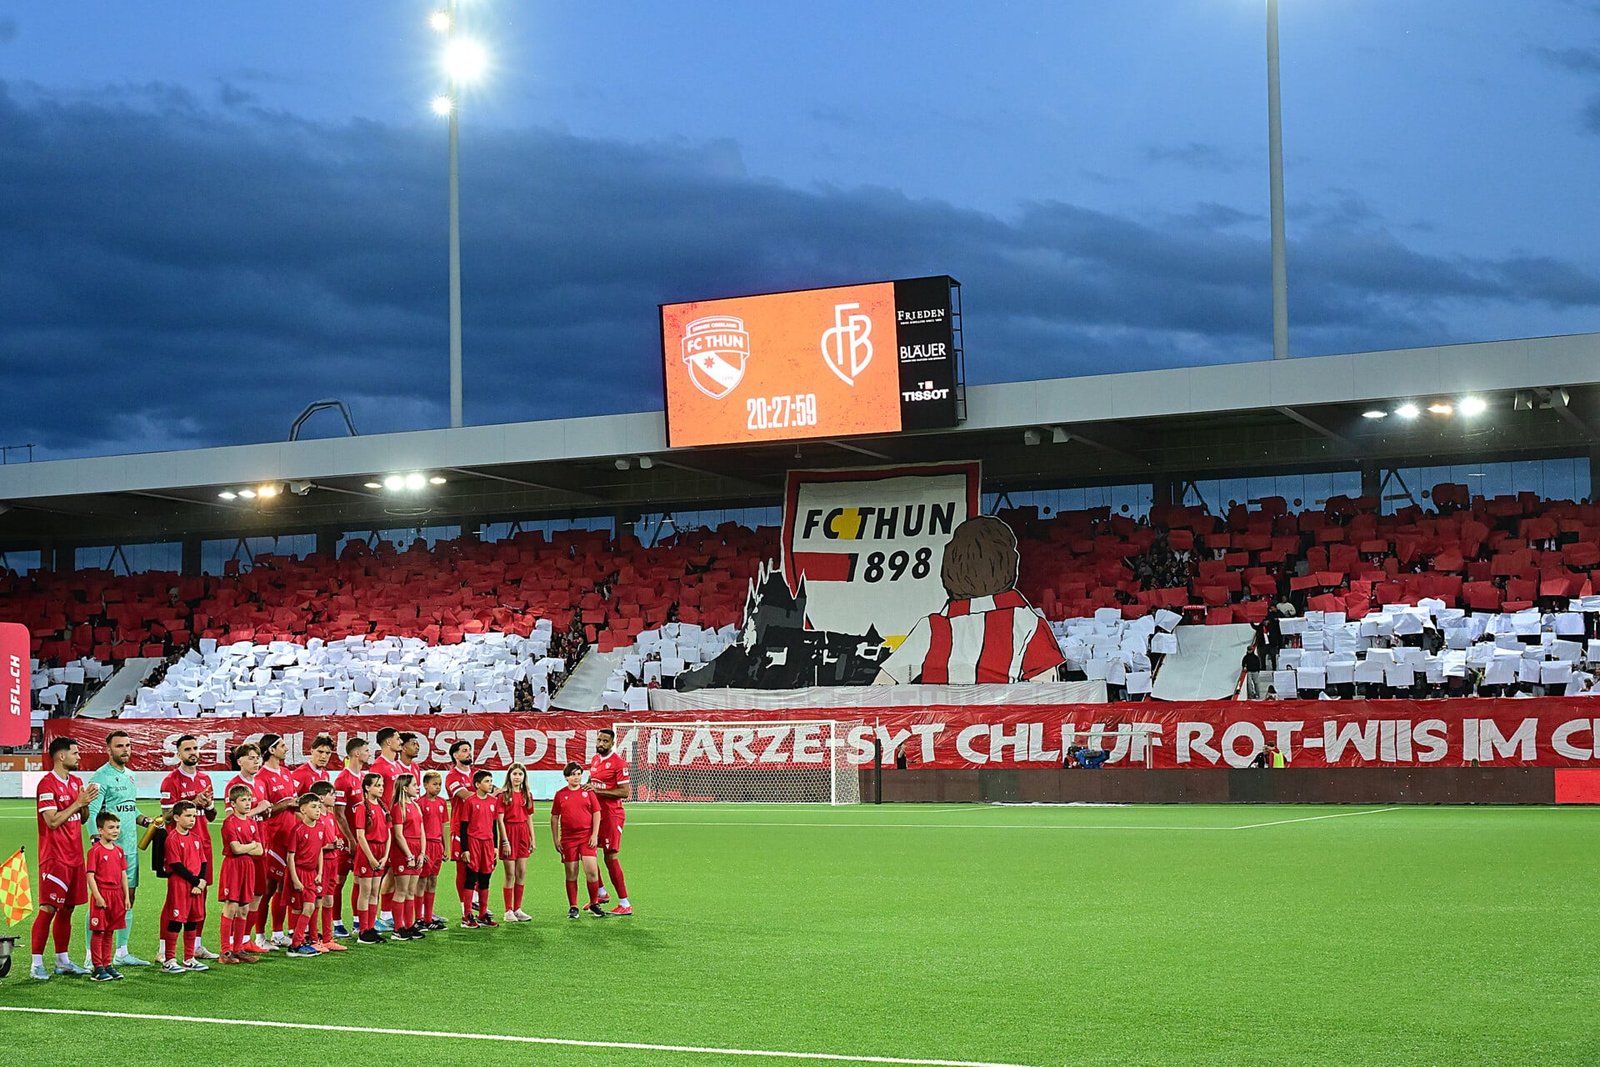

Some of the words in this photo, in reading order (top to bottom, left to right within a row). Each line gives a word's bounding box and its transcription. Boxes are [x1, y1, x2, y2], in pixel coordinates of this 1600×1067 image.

[687, 337, 703, 353] FC
[704, 334, 744, 348] THUN
[900, 342, 947, 360] BLÄUER
[746, 393, 817, 430] 20:27:59
[902, 388, 950, 402] TISSOT
[802, 507, 843, 540] FC
[855, 502, 955, 540] THUN
[847, 547, 932, 583] 1898
[9, 654, 20, 716] SFL.CH
[1176, 719, 1449, 768] ROT-WIIS
[1462, 717, 1539, 761] IM
[1551, 718, 1600, 761] C
